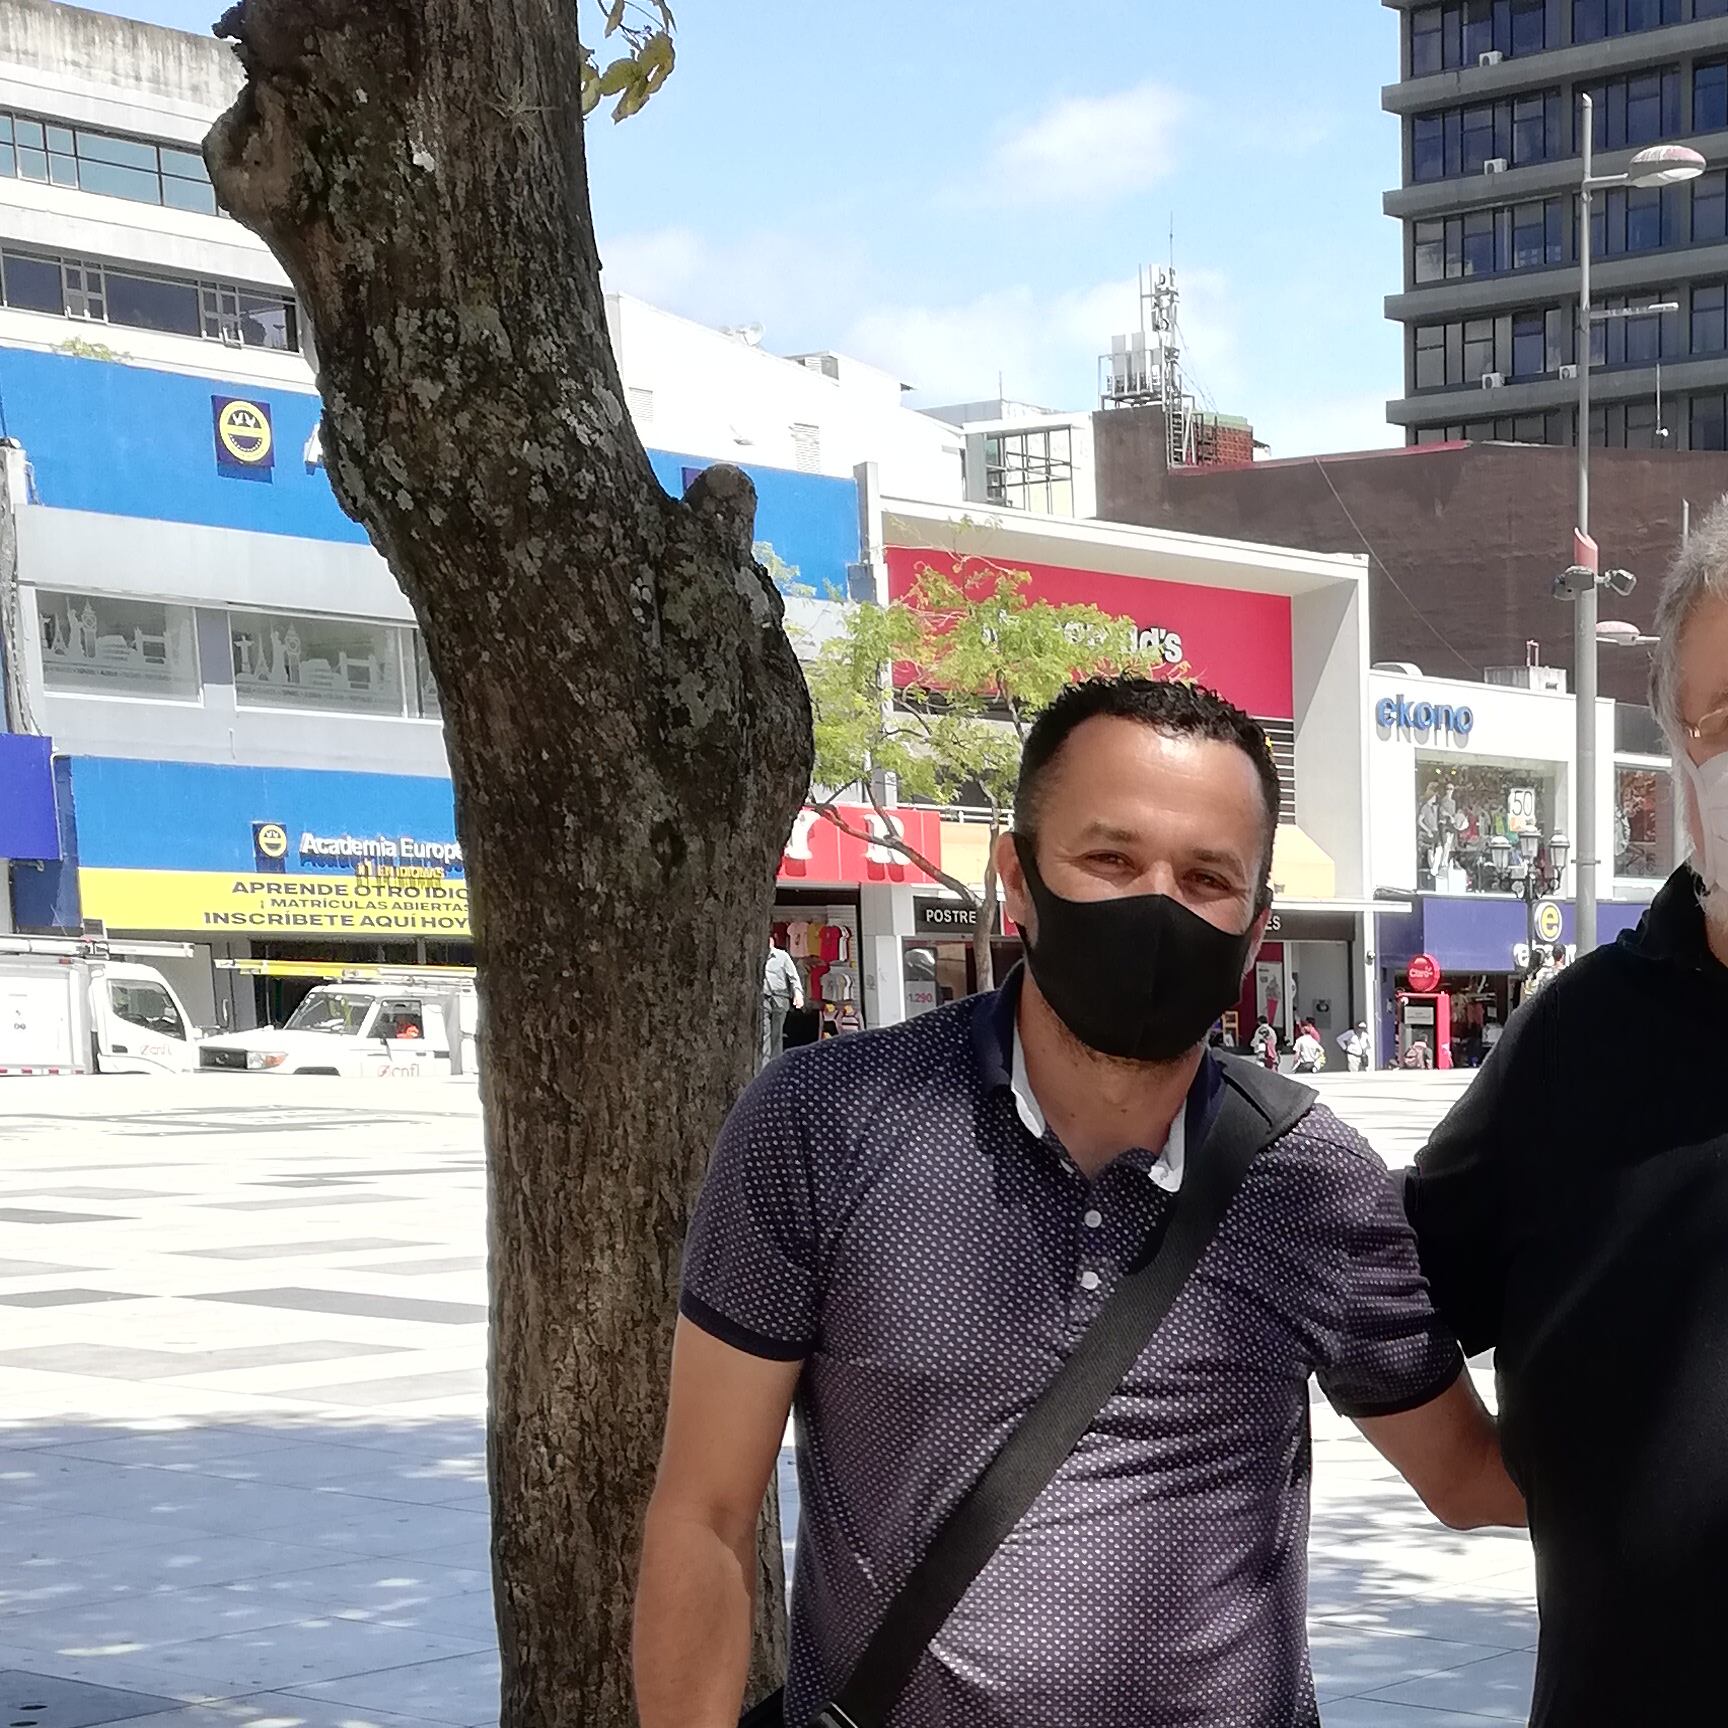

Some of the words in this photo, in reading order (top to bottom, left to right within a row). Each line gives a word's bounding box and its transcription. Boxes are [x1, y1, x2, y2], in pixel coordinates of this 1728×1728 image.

[1375, 693, 1473, 735] ekono
[1511, 790, 1534, 816] 50
[300, 832, 397, 857] Academia
[400, 837, 463, 863] Europe
[232, 882, 348, 896] APRENDE
[354, 884, 419, 898] OTRO
[425, 886, 470, 899] IDIO
[270, 897, 388, 910] MATRÍCULAS
[204, 910, 355, 927] INSCRÍBETE
[360, 913, 416, 928] AQUÍ
[421, 916, 468, 929] HOY
[926, 909, 977, 924] POSTRE
